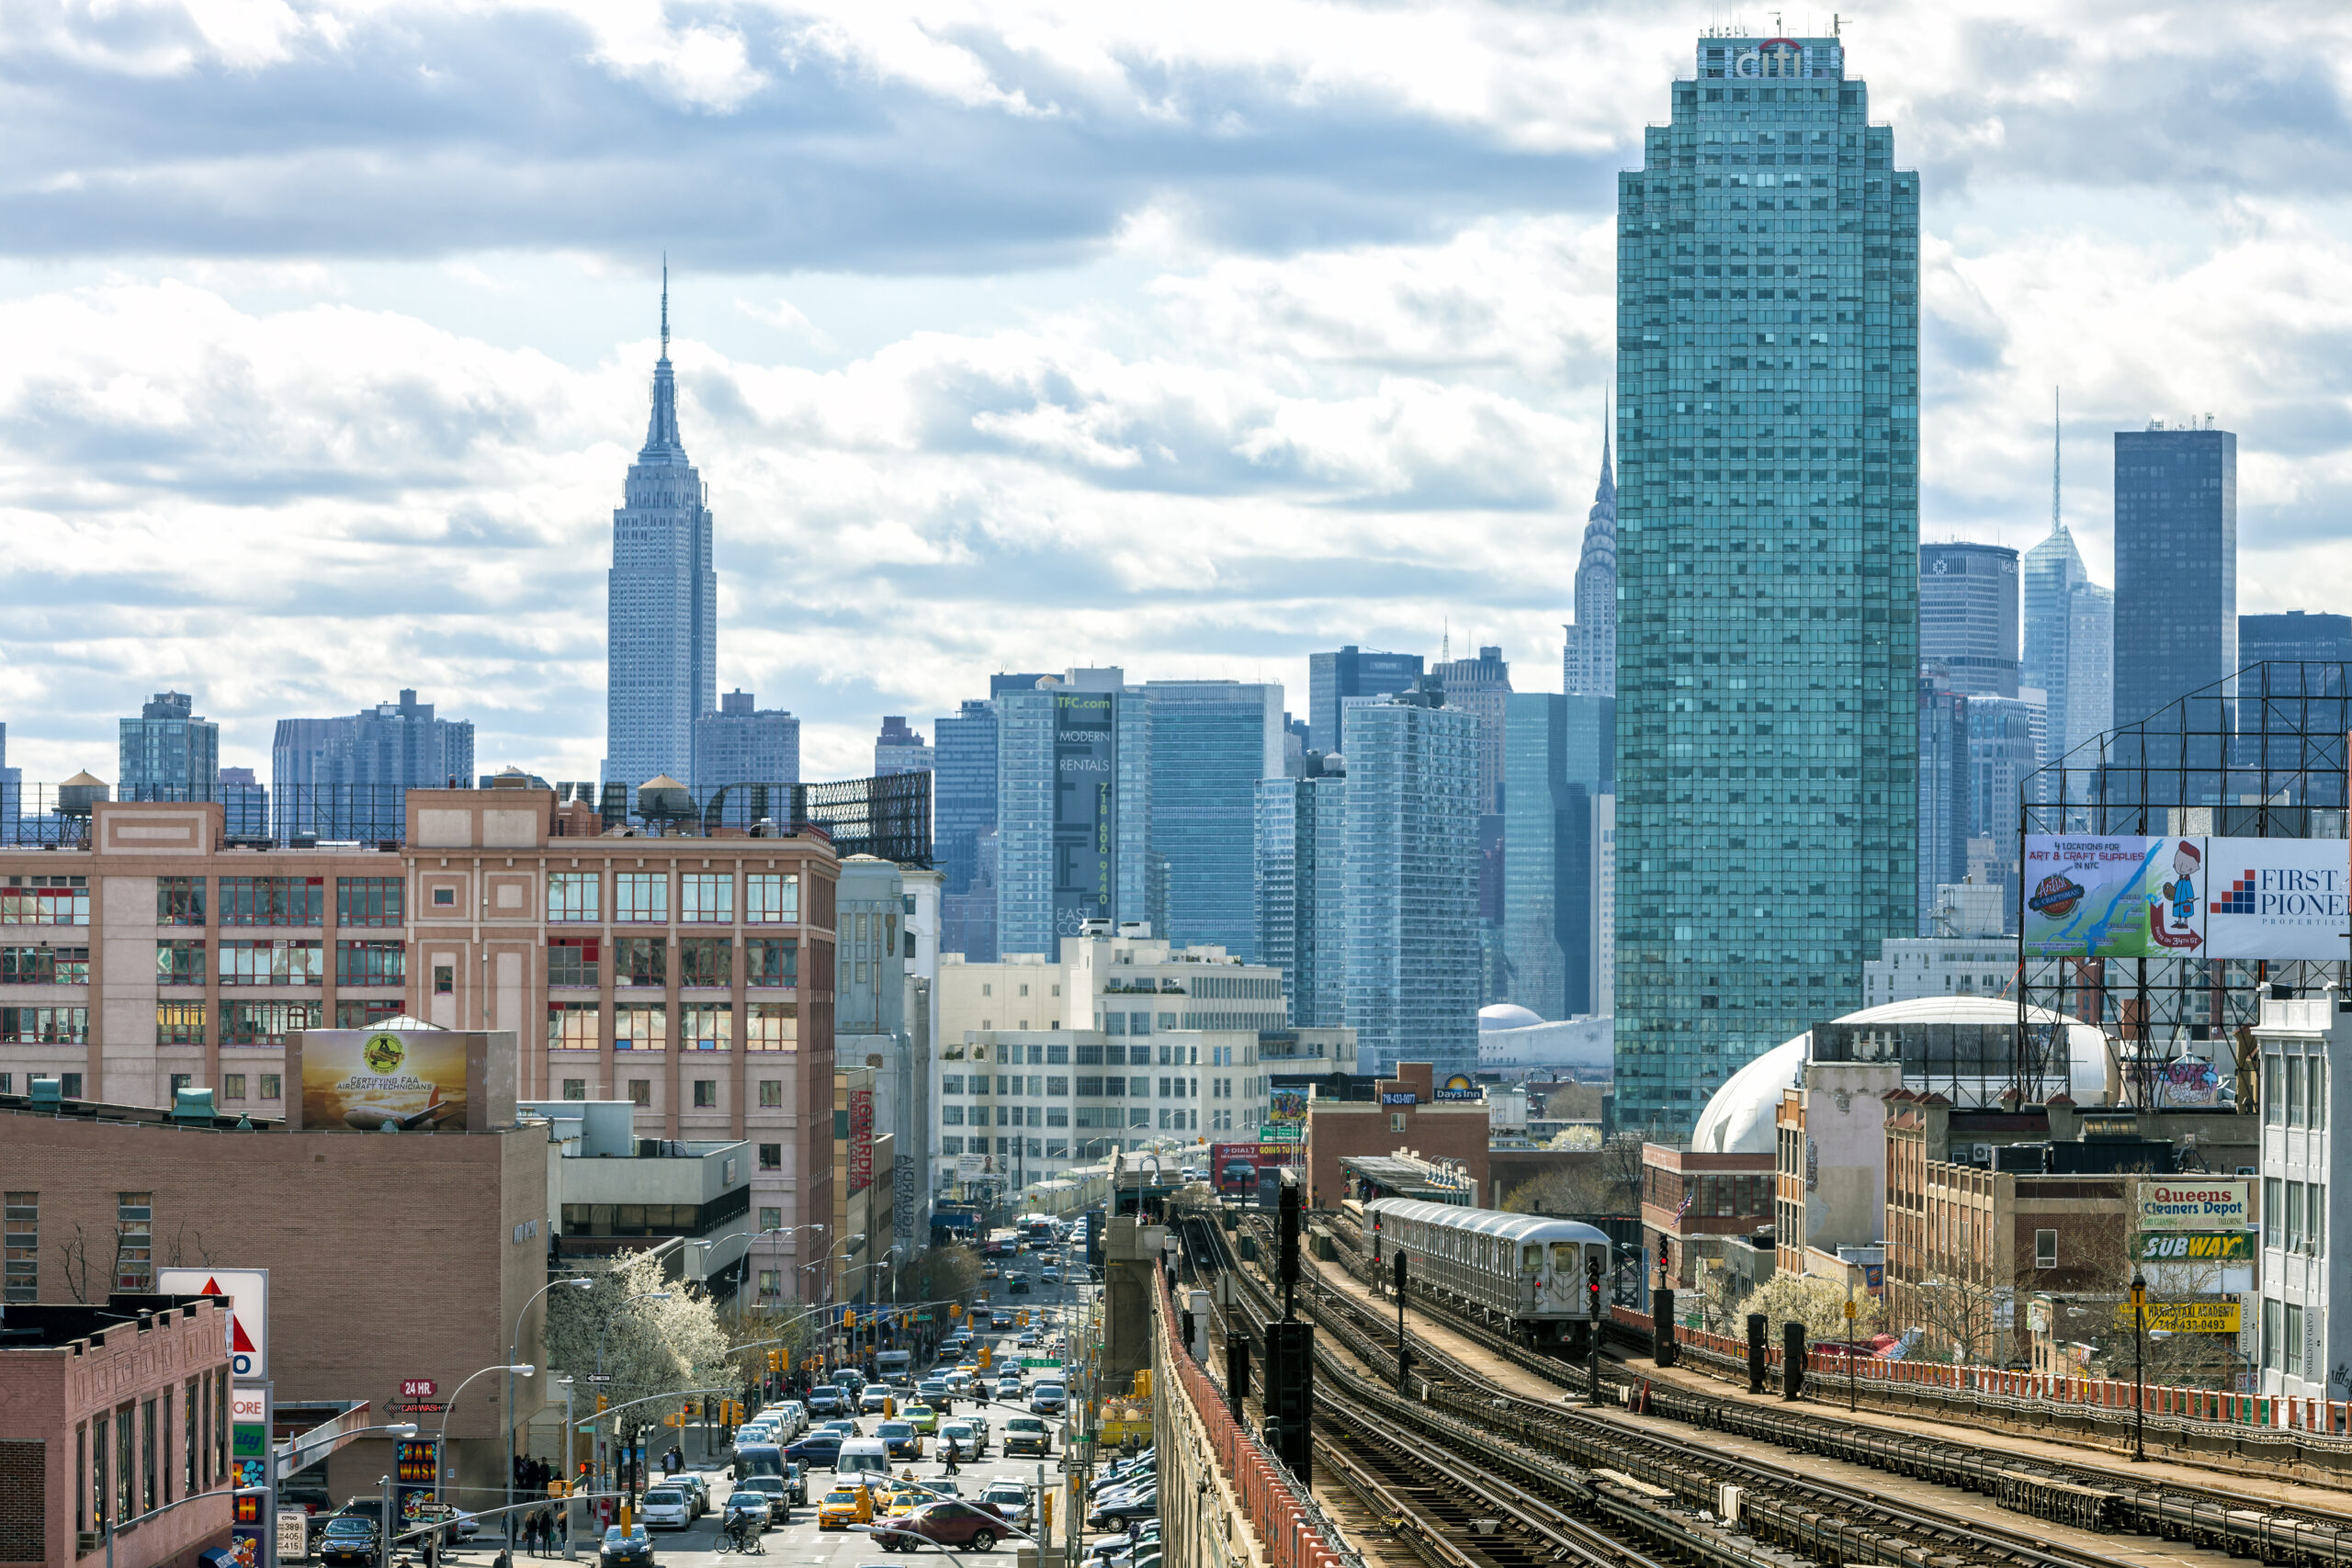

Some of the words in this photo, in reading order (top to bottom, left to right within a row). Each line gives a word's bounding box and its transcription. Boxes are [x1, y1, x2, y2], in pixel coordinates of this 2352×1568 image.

[1736, 44, 1801, 79] citi
[1057, 696, 1111, 709] TFC.com
[1059, 731, 1110, 742] MODERN
[1059, 759, 1110, 772] RENTALS
[2054, 842, 2060, 851] 4
[2062, 842, 2103, 851] LOCATIONS
[2104, 843, 2120, 852] FOR
[2029, 851, 2050, 861] ART
[2053, 852, 2061, 861] &
[2064, 852, 2096, 861] CRAFT
[2098, 852, 2145, 861] SUPPLIES
[2084, 862, 2099, 870] NYC
[2260, 869, 2338, 891] FIRST
[2041, 888, 2080, 905] CRAFTSMAN
[1057, 908, 1091, 921] EAST
[1383, 1094, 1415, 1104] 718-433-0077
[1436, 1090, 1463, 1100] Days
[1464, 1090, 1481, 1099] Inn
[850, 1090, 858, 1146] COMMUNITY
[850, 1148, 858, 1190] COLLEGE
[2154, 1187, 2232, 1202] Queens
[2143, 1202, 2199, 1214] Cleaners
[2203, 1201, 2243, 1216] Depot
[2143, 1235, 2244, 1258] SUBWAY
[2132, 1288, 2143, 1303] T
[2177, 1305, 2195, 1317] TAXI
[2198, 1305, 2234, 1317] ACADEMY
[2159, 1319, 2225, 1330] 718433-0493
[405, 1382, 416, 1394] 24
[417, 1382, 432, 1394] HR.
[233, 1401, 262, 1415] ORE
[401, 1404, 417, 1412] CAR
[417, 1404, 441, 1412] WASH
[404, 1443, 433, 1461] CAR
[399, 1463, 436, 1480] WASH
[285, 1523, 300, 1531] 389
[284, 1532, 300, 1540] 405
[284, 1542, 299, 1551] 415
